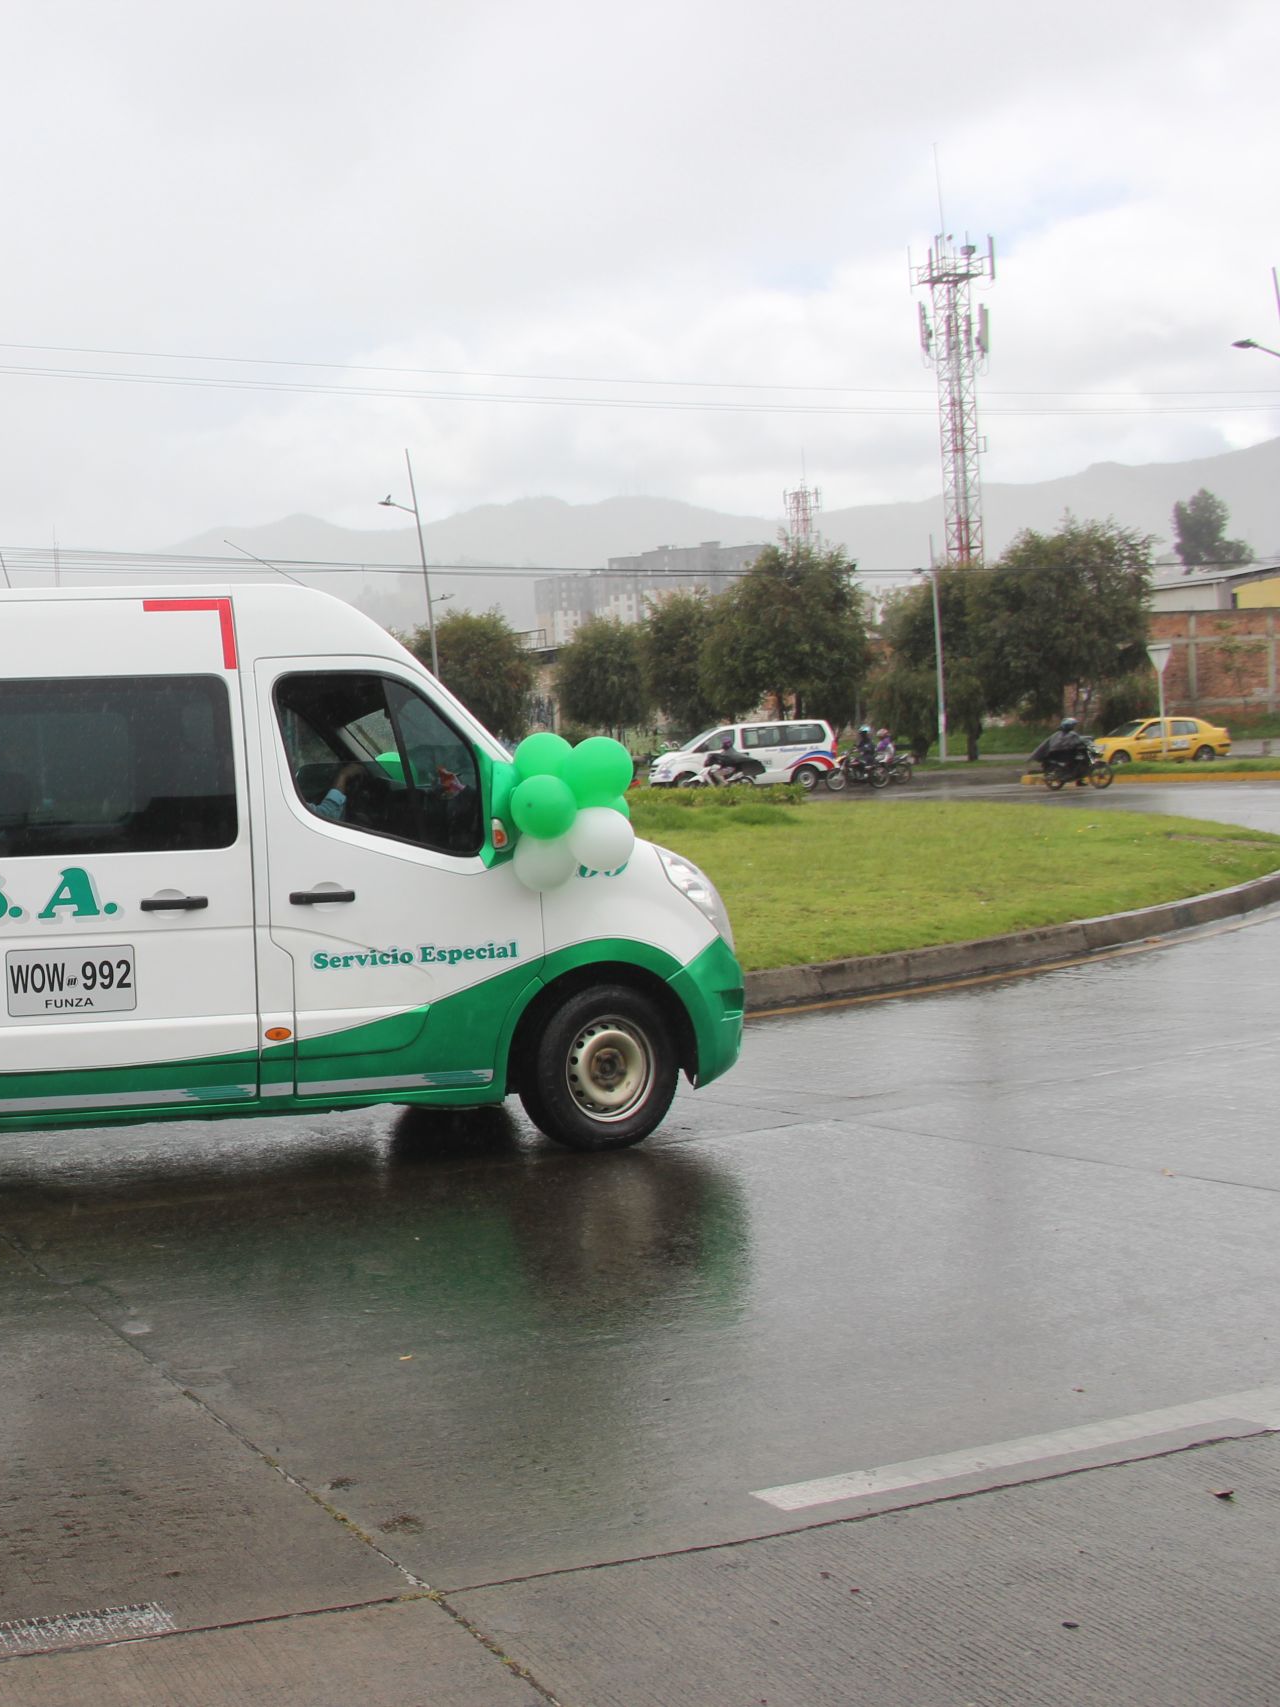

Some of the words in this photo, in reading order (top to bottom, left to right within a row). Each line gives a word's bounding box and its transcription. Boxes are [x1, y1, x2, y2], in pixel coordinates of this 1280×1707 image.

[313, 948, 414, 969] Servicio
[420, 942, 517, 964] Especial
[9, 963, 65, 994] WOW
[81, 959, 131, 991] 992
[45, 997, 94, 1008] FUNZA
